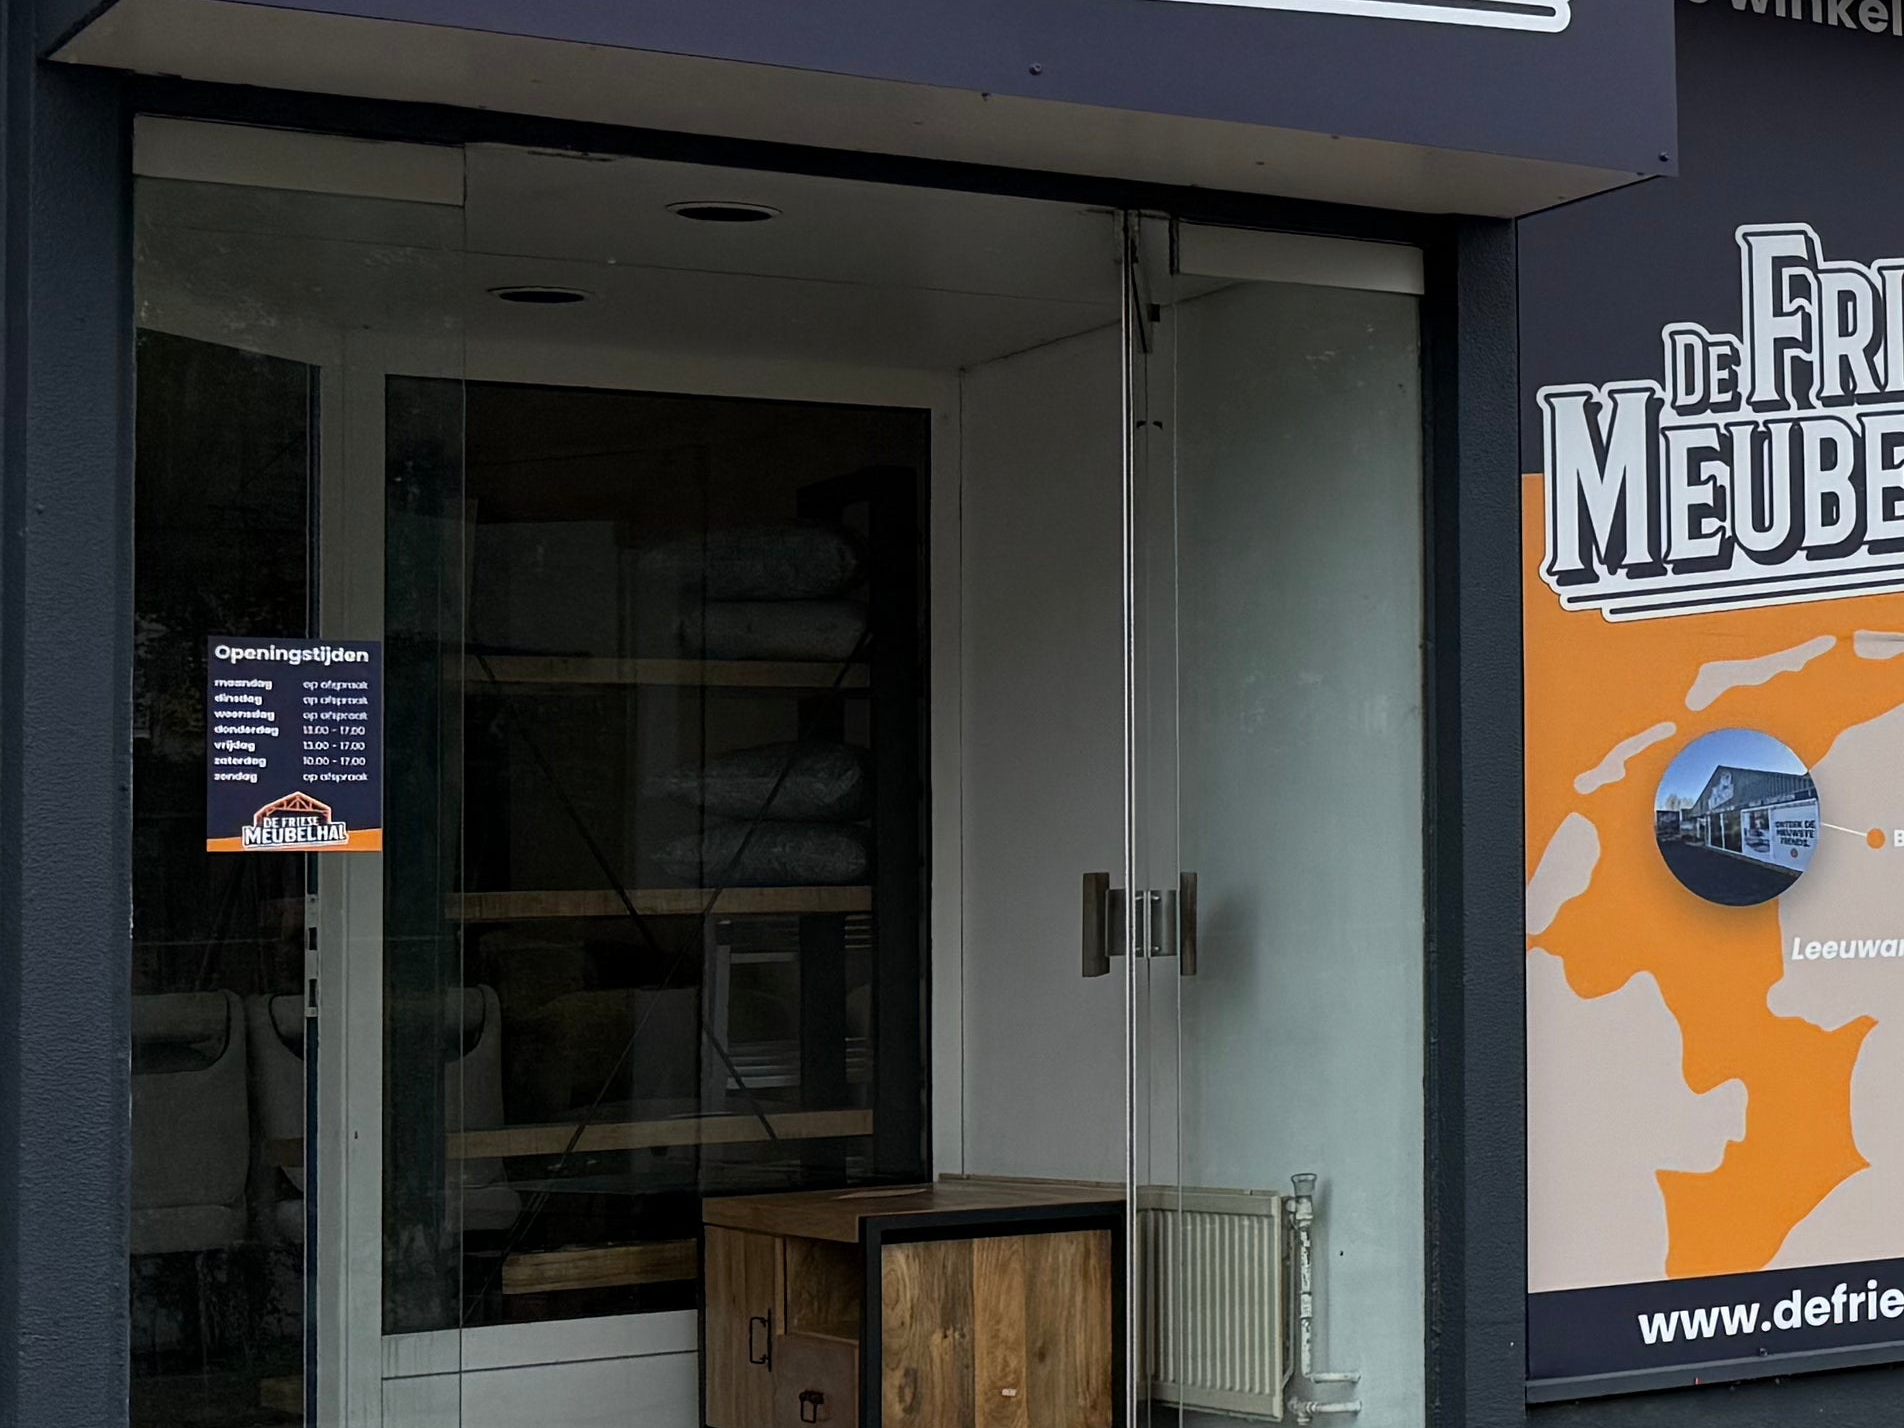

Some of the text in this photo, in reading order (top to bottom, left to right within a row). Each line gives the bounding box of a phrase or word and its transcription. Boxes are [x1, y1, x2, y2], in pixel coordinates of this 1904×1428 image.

[1671, 332, 1739, 414] DE
[213, 644, 370, 667] Openingstijden
[213, 740, 256, 753] vrijdag
[213, 756, 268, 768] zaterdag
[262, 816, 280, 828] DE
[244, 824, 347, 845] MEUBELHAL
